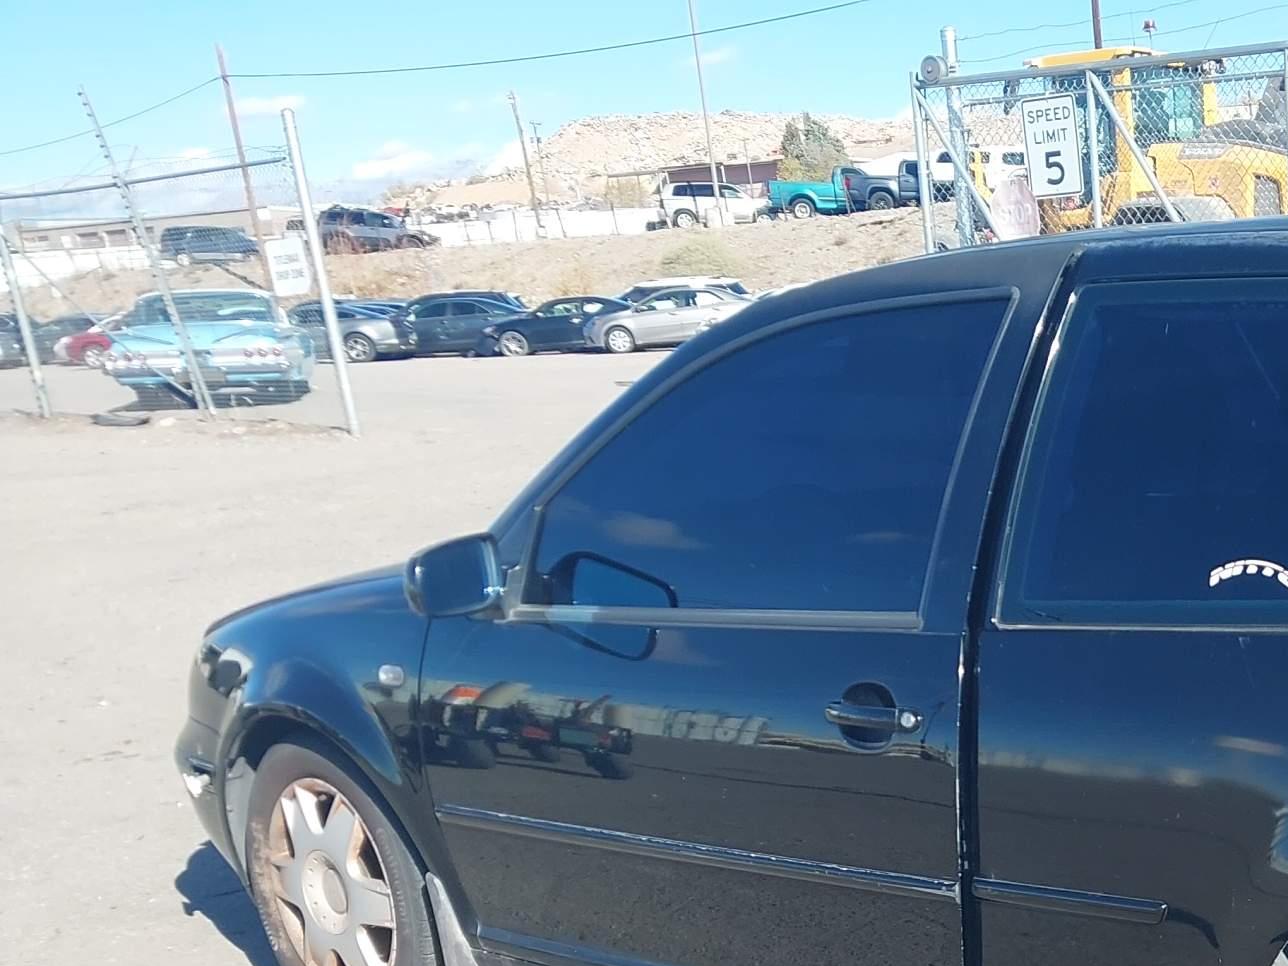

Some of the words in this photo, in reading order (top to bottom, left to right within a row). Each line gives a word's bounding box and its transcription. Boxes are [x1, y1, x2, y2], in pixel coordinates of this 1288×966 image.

[1027, 106, 1071, 124] SPEED
[1034, 128, 1067, 145] LIMIT
[1045, 150, 1065, 185] 5
[998, 203, 1033, 225] STOP
